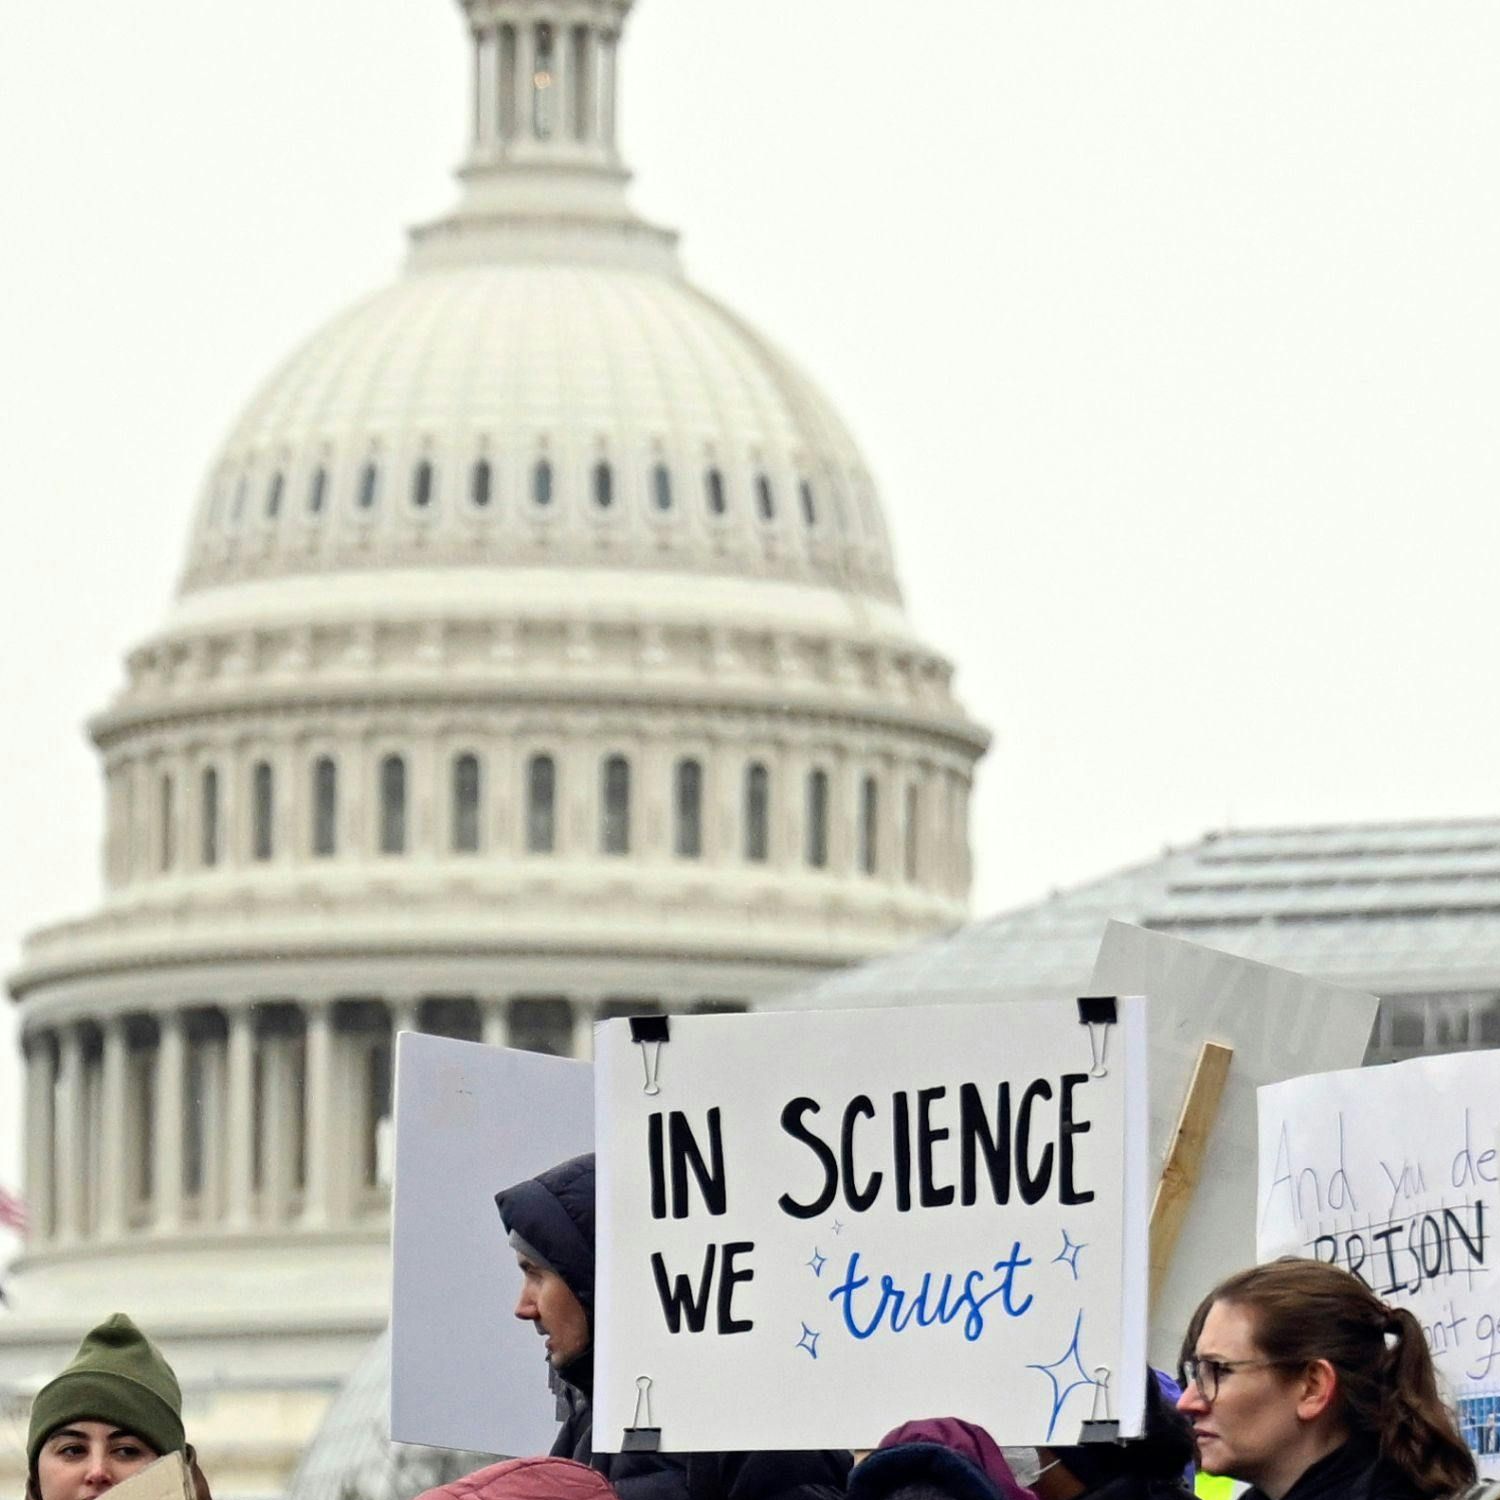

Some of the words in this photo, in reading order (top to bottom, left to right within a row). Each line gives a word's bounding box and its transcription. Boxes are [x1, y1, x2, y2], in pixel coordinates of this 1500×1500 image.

[647, 1106, 726, 1219] IN
[777, 1073, 1095, 1219] SCIENCE
[1257, 1112, 1357, 1228] And
[650, 1241, 755, 1335] WE
[829, 1241, 1033, 1341] trust
[1314, 1200, 1483, 1296] PRISON
